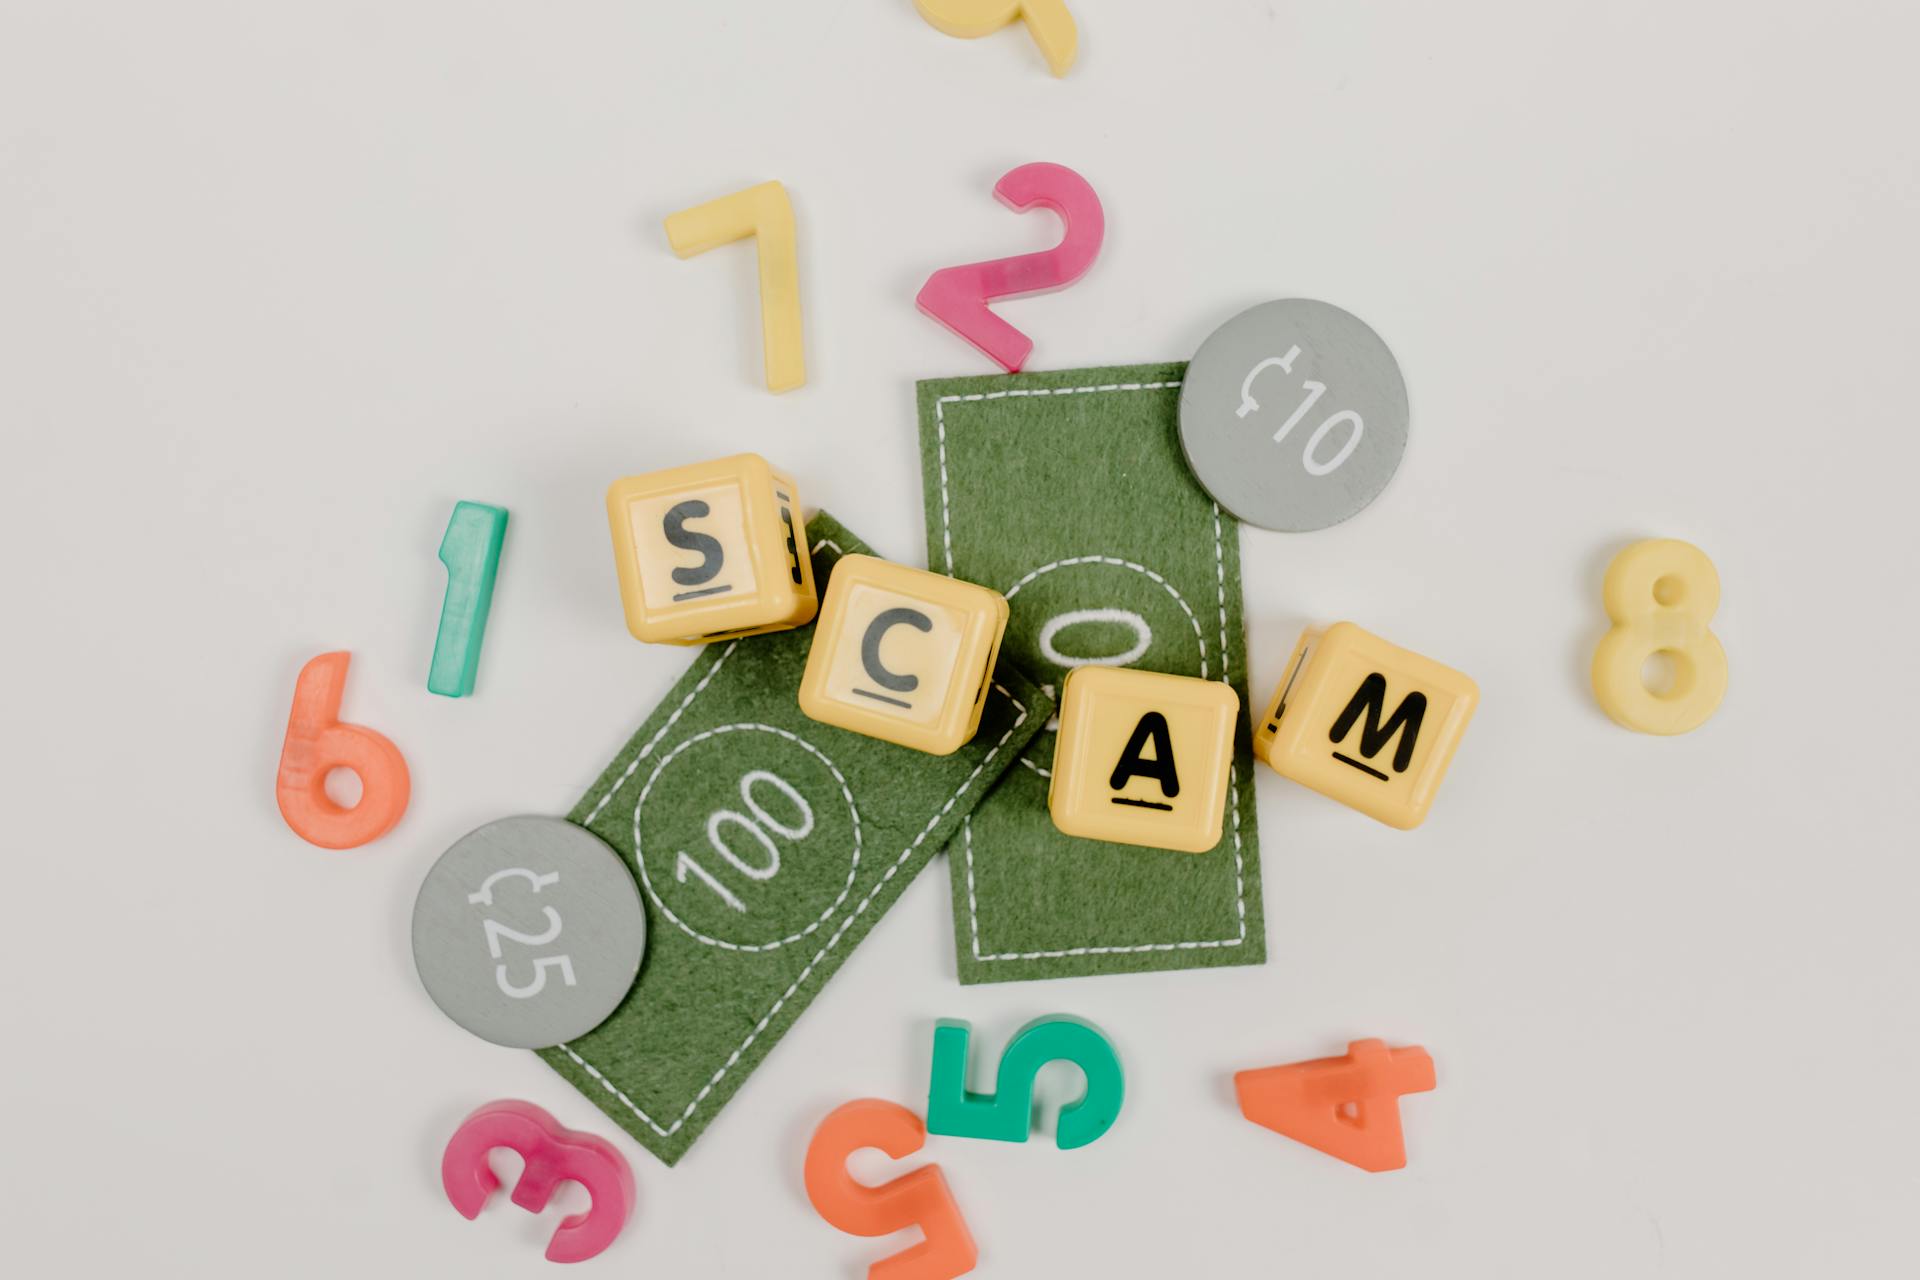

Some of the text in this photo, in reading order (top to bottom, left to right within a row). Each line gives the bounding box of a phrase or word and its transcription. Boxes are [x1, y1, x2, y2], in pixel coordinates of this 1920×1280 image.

[663, 180, 806, 394] 7
[915, 162, 1104, 373] 2
[427, 501, 509, 698] 1
[1591, 538, 1728, 736] 8
[275, 650, 411, 850] 6
[676, 770, 814, 912] 100
[927, 1013, 1125, 1150] 5
[1234, 1038, 1437, 1173] 4
[442, 1099, 636, 1264] 3
[804, 1098, 979, 1280] 5
